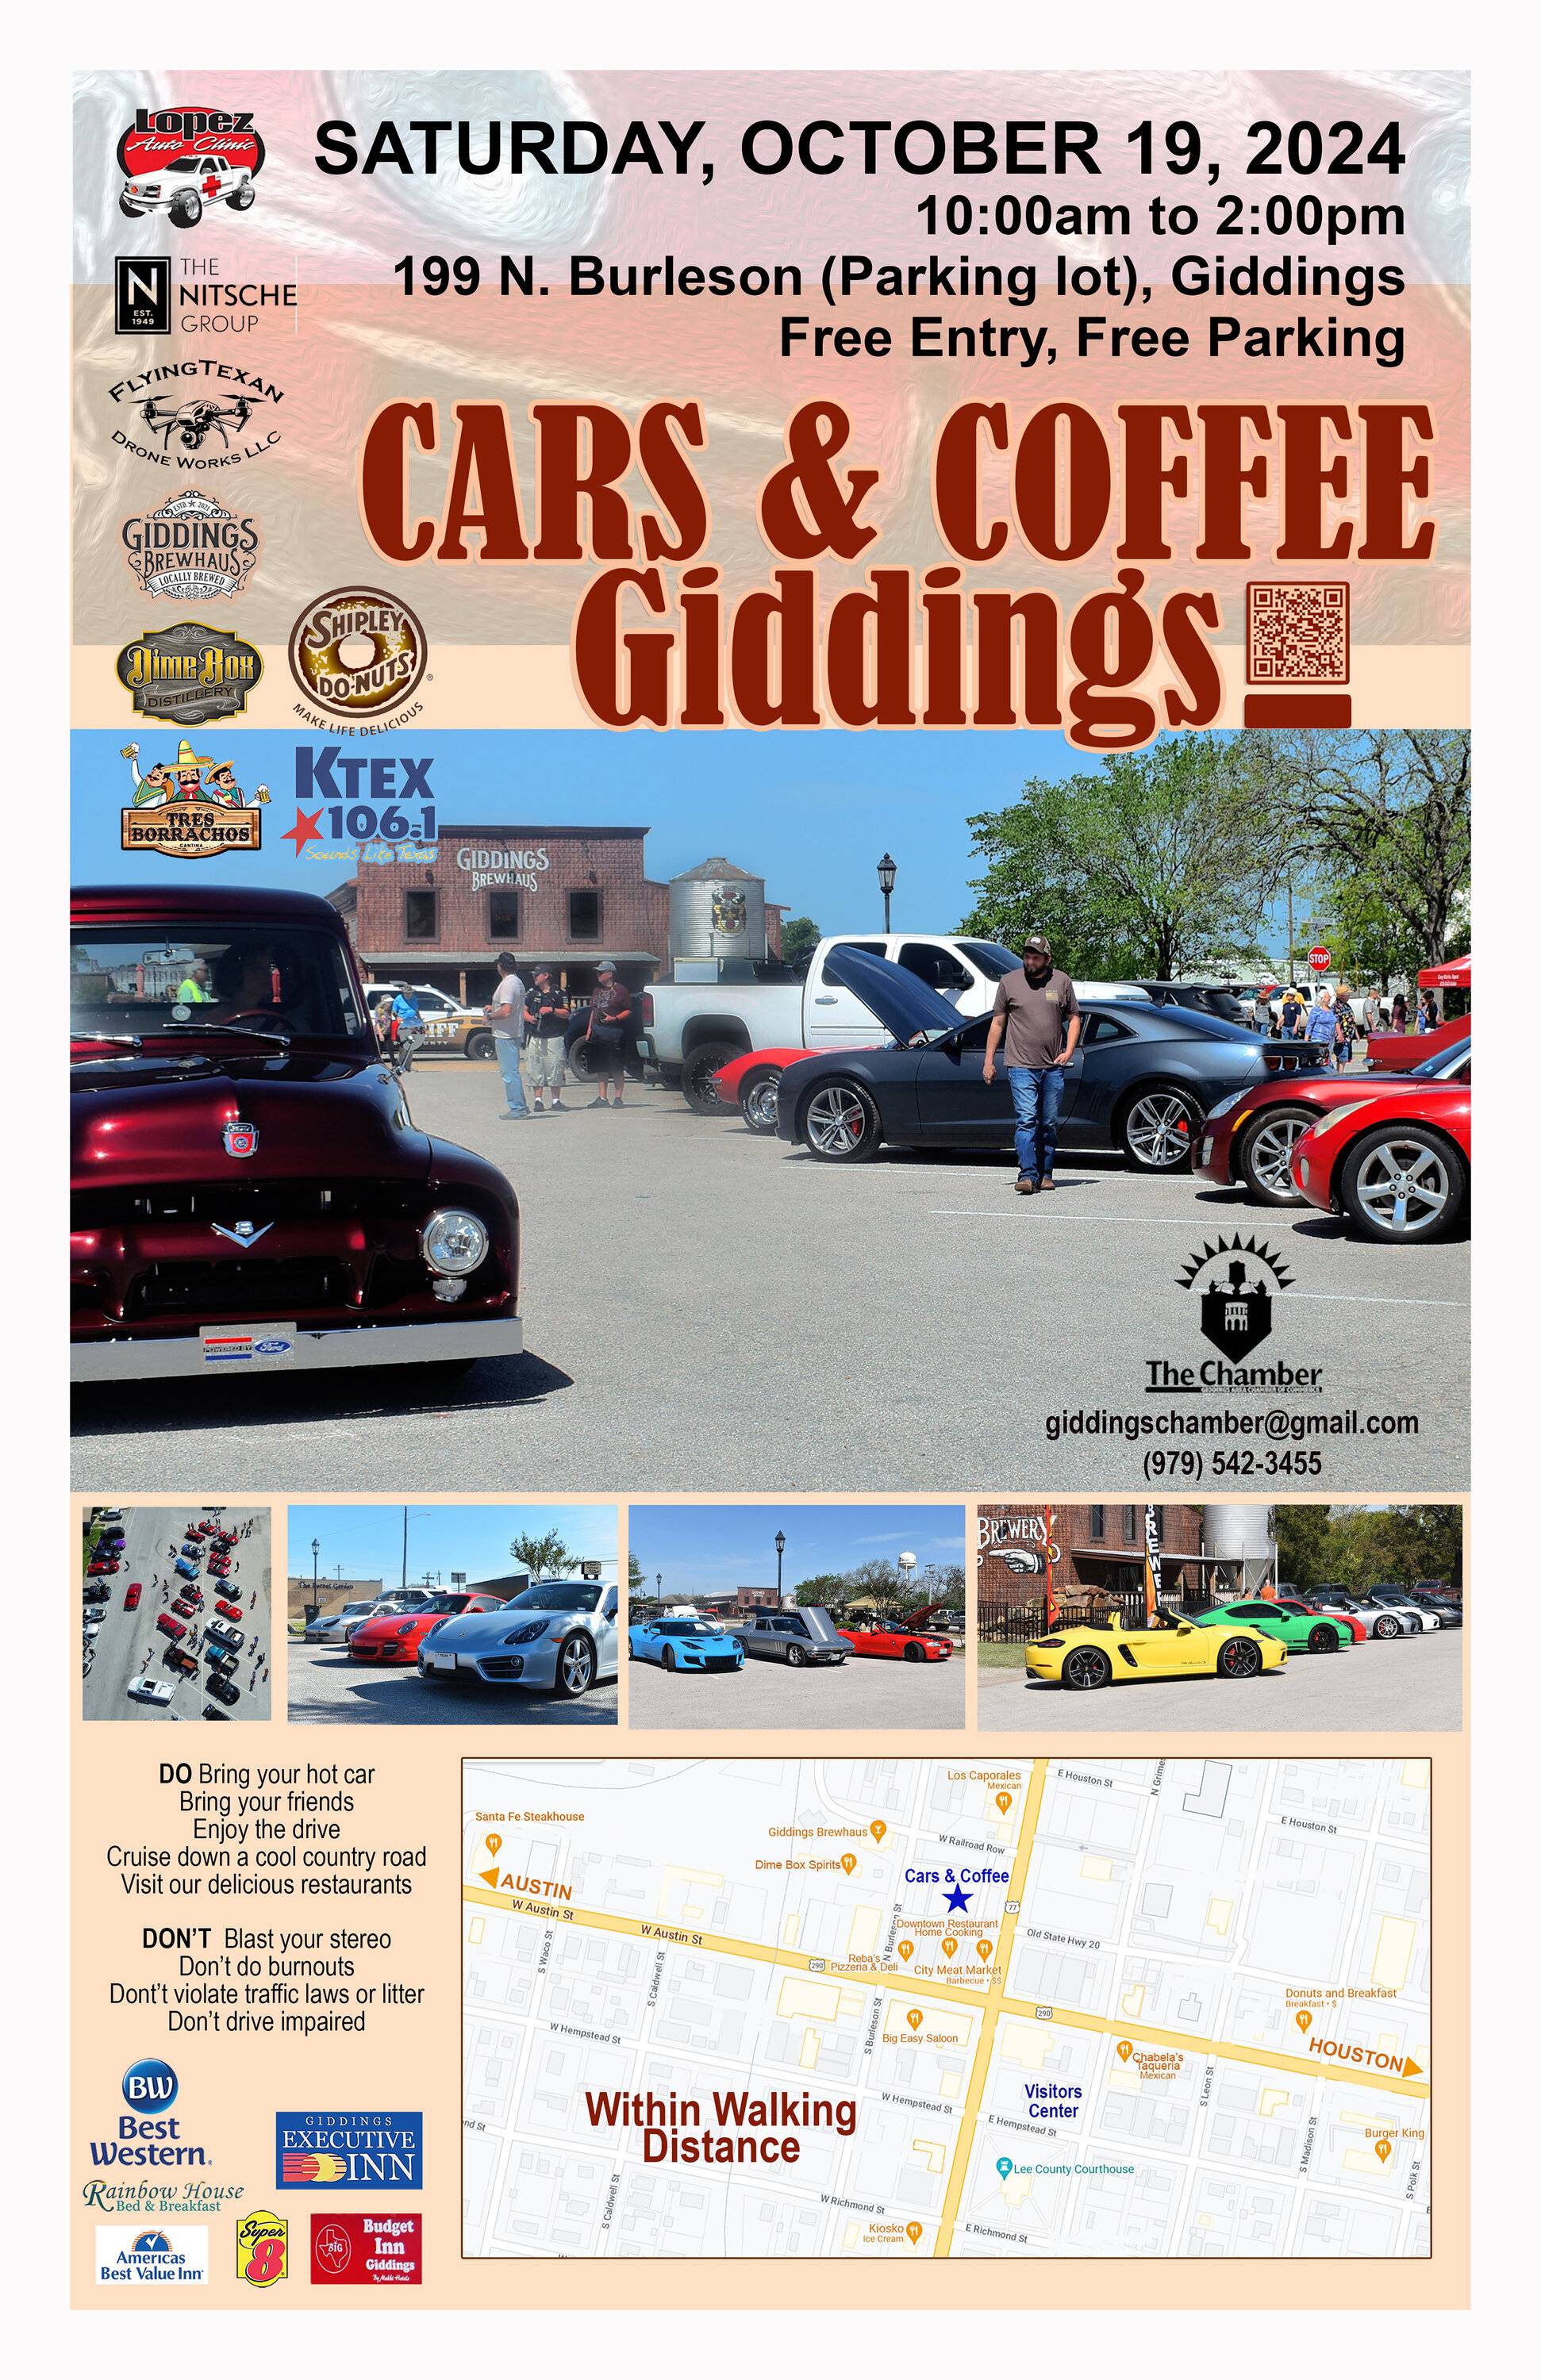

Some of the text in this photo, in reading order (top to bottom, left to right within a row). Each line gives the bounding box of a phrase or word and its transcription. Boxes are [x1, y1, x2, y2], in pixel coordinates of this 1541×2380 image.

[135, 109, 255, 140] Lopez
[127, 135, 256, 152] Auto Clinic
[314, 119, 1406, 187] SATURDAY, OCTOBER 19, 2024
[917, 194, 1405, 245] 10:00am to 2:00pm
[180, 259, 219, 275] THE
[129, 267, 158, 305] N
[394, 255, 1405, 306] 199 N. Burleson (Parking lot), Giddings
[180, 284, 297, 306] NITSCHE
[181, 315, 259, 332] GROUP
[780, 317, 1405, 367] Free Entry, Free Parking
[112, 431, 282, 469] DRONE WORKS LLC
[362, 401, 1435, 561] CARS & COFFEE
[198, 501, 209, 512] 2021
[122, 519, 259, 553] GIDDINGS
[144, 549, 240, 576] BREWHAUS
[159, 572, 225, 585] LOCALLY BREWED
[308, 608, 404, 648] SHIPLEY
[126, 647, 254, 687] Dime Box
[575, 566, 1224, 750] Giddings
[148, 686, 232, 708] DISTILLERY
[293, 702, 423, 737] MAKE LIFE DELICIOUS
[165, 812, 215, 826] TRES
[328, 805, 435, 839] 106.1
[132, 827, 250, 842] BORRACHOS
[306, 846, 436, 862] Sounds Like Texas
[457, 847, 550, 871] GIDDINGS
[472, 872, 538, 892] BREWHAUS
[1309, 954, 1329, 964] STOP
[1146, 1361, 1322, 1386] The Chamber
[1046, 1410, 1419, 1440] giddingschamber@gmail.com
[1143, 1450, 1321, 1480] (979) 542-3455
[978, 1514, 1058, 1555] BREWERY
[159, 1764, 375, 1788] DO Bring your hot car
[947, 1771, 1021, 1782] Los Caporales
[180, 1791, 354, 1816] Bring your friends
[476, 1812, 585, 1821] Santa Fe Steakhouse
[194, 1819, 340, 1844] Enjoy the drive
[768, 1827, 867, 1837] Giddings Brewhaus
[107, 1846, 426, 1871] Cruise down a cool country road
[755, 1860, 841, 1870] Dime Box Spirits
[121, 1873, 412, 1894] Visit our delicious restaurants
[501, 1873, 572, 1900] AUSTIN
[905, 1869, 1009, 1883] Cars & Coffee
[143, 1928, 390, 1953] DON'T Blast your stereo
[180, 1956, 355, 1975] Don't do burnouts
[110, 1983, 425, 2003] Dont't violate traffic laws or litter
[168, 2011, 365, 2036] Don't drive impaired
[1309, 2037, 1403, 2072] HOUSTON
[129, 2076, 173, 2098] BW
[1024, 2084, 1082, 2099] Visitors
[306, 2117, 393, 2125] GIDDINGS
[586, 2091, 856, 2136] Within Walking
[1029, 2103, 1078, 2118] Center
[119, 2117, 180, 2139] Best
[1365, 2129, 1424, 2140] Burger King
[282, 2131, 415, 2149] EXECUTIVE
[644, 2129, 800, 2163] Distance
[90, 2142, 206, 2165] Western
[347, 2153, 414, 2181] INN
[1014, 2164, 1135, 2175] Lee County Courthouse
[83, 2180, 244, 2212] Rainbow House
[117, 2200, 221, 2212] Bed & Breakfast
[240, 2221, 286, 2238] Super
[363, 2220, 414, 2235] Budget
[375, 2237, 405, 2255] Inn
[117, 2251, 186, 2264] Americas
[247, 2239, 285, 2282] 8
[366, 2259, 415, 2272] Giddings
[102, 2267, 201, 2280] Best Value Inn
